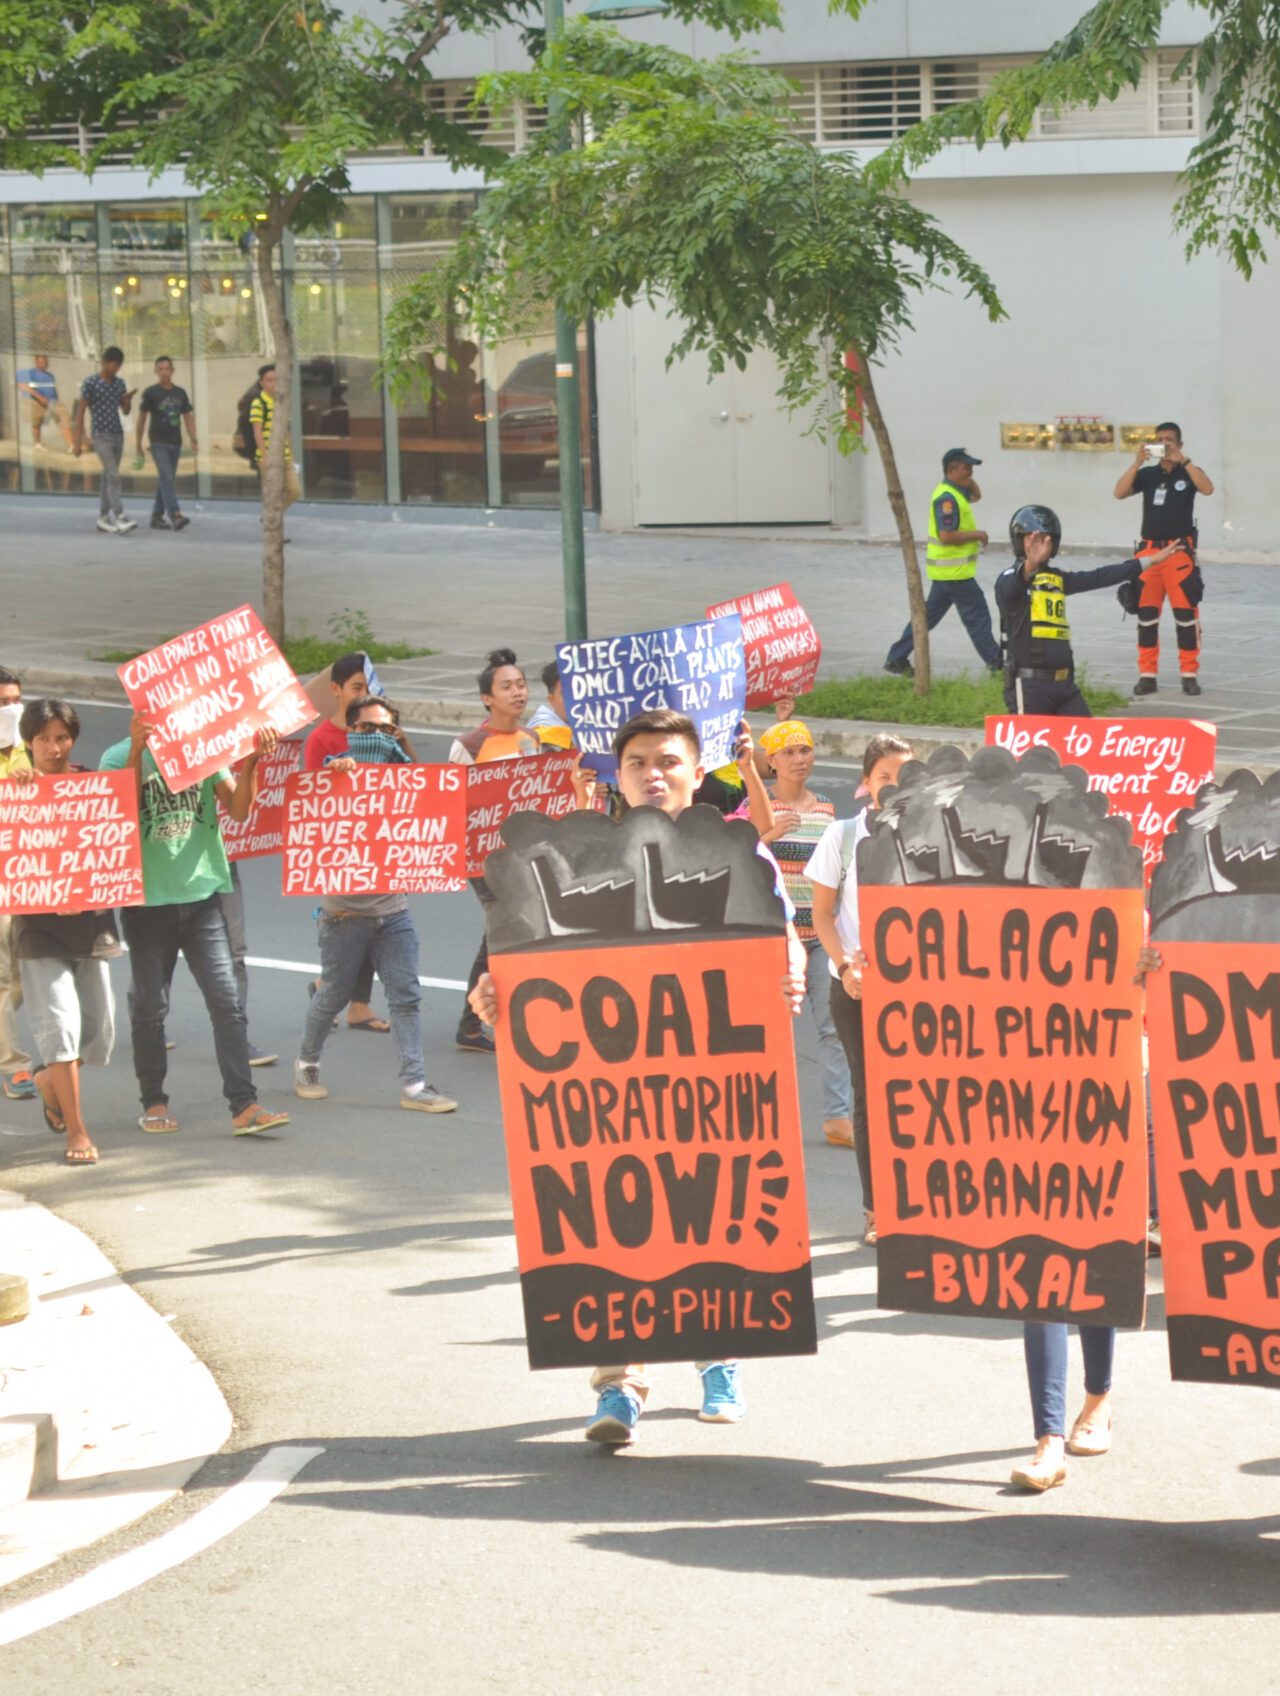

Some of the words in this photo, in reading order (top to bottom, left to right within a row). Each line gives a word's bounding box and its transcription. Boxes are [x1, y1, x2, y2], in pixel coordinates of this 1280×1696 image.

[695, 623, 716, 651] AT
[572, 668, 625, 700] DMCI
[632, 657, 685, 691] COAL
[686, 638, 742, 679] PLANTS
[145, 667, 193, 715] KILLS!
[195, 655, 221, 687] NO
[718, 672, 737, 701] AT
[162, 756, 181, 778] in
[182, 717, 254, 769] Batangas
[1063, 725, 1093, 757] to
[1099, 725, 1186, 772] Energy
[0, 782, 39, 802] AND
[53, 776, 114, 799] SOCIAL
[296, 771, 332, 795] 35
[348, 767, 427, 792] YEARS
[439, 769, 460, 791] IS
[467, 762, 511, 788] Break
[507, 772, 565, 801] COAL!
[288, 794, 385, 821] ENOUGH
[391, 792, 418, 815] !!!
[467, 803, 503, 832] SAVE
[18, 825, 68, 851] NOW!
[77, 821, 136, 850] STOP
[288, 821, 368, 846] NEVER
[376, 817, 447, 842] AGAIN
[4, 852, 52, 880] COAL
[58, 844, 132, 874] PLANT
[286, 848, 314, 869] TO
[315, 845, 375, 867] COAL
[384, 844, 458, 867] POWER
[90, 867, 143, 887] POWER
[286, 866, 379, 894] PLANTS!
[874, 906, 1120, 988] CALACA
[509, 969, 767, 1074] COAL
[877, 999, 984, 1060] COAL
[994, 1001, 1134, 1060] PLANT
[519, 1070, 780, 1152] MORATORIUM
[884, 1076, 1132, 1151] EXPANSION
[530, 1151, 753, 1257] NOW!
[892, 1157, 1126, 1223] LABANAN!
